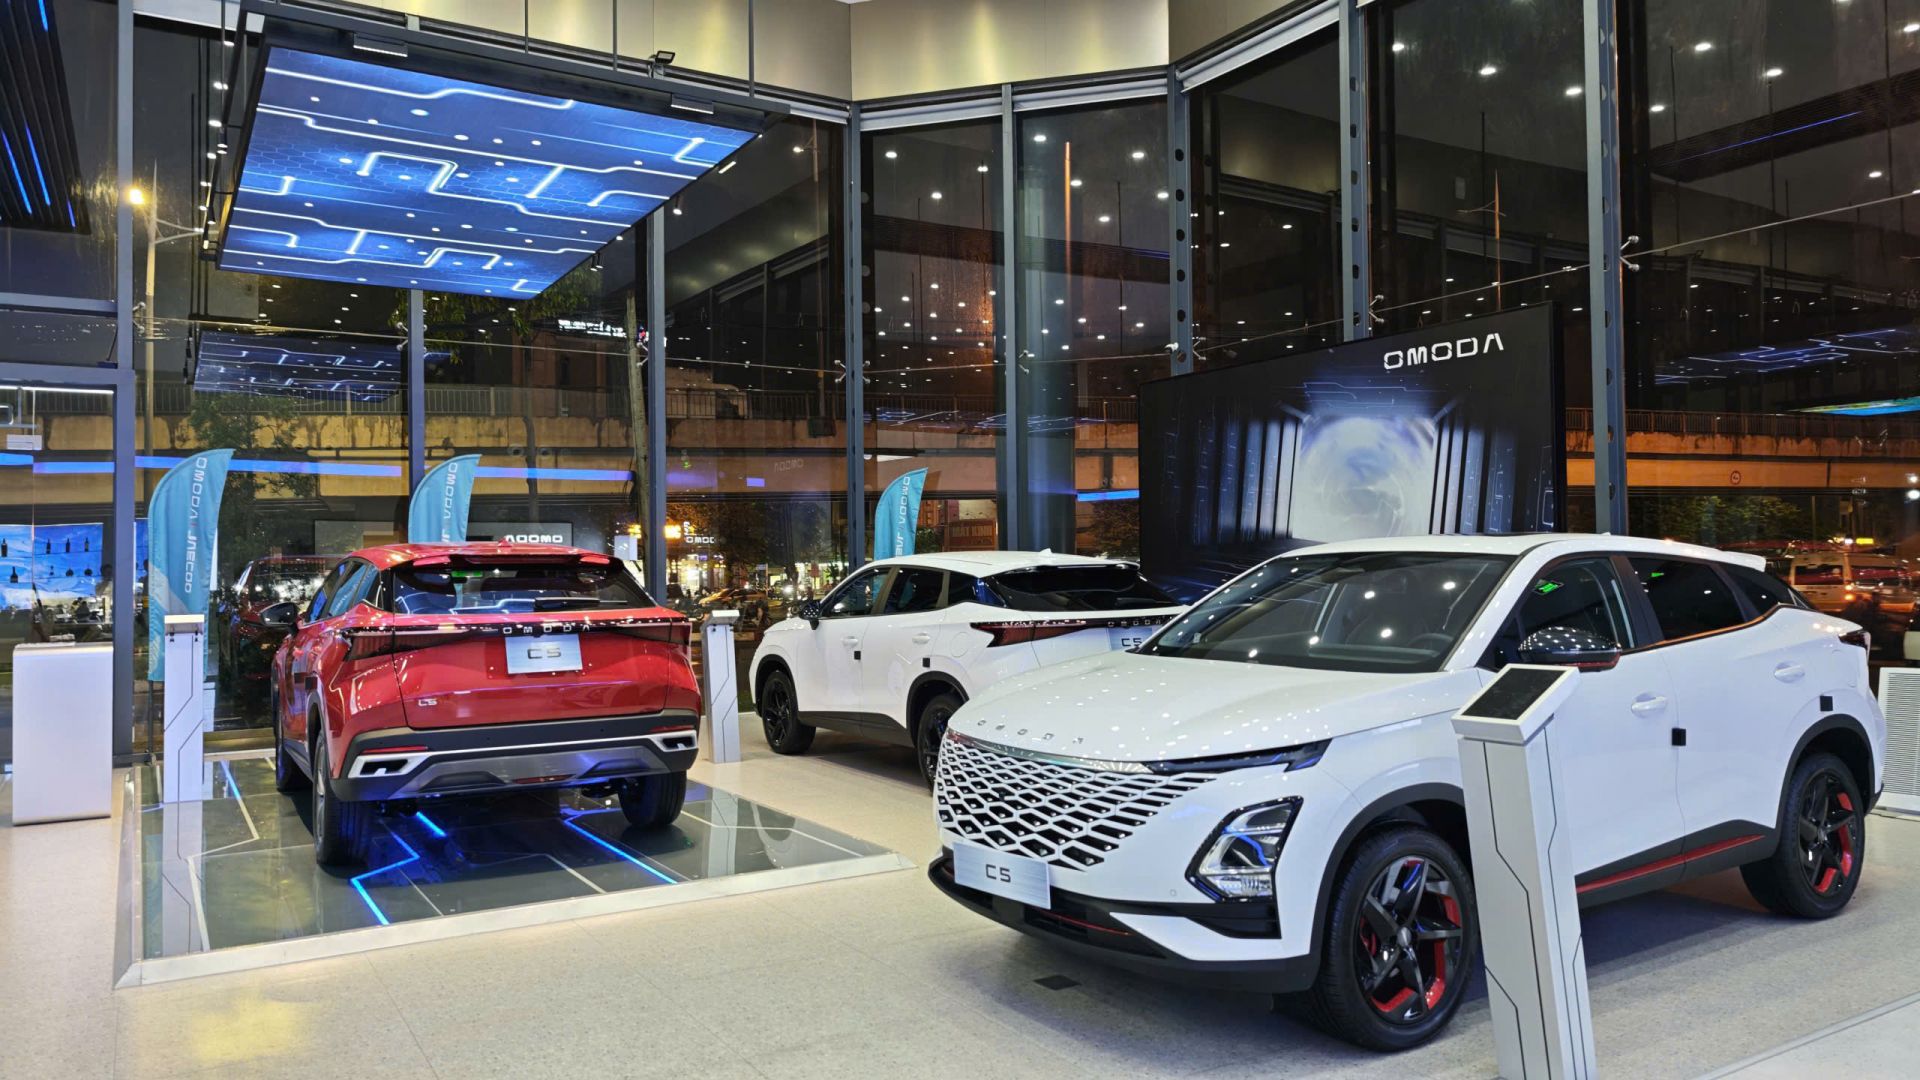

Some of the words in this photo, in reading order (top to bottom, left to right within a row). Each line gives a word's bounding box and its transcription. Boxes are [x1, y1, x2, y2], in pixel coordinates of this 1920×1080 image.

[1383, 333, 1504, 370] OMODA
[189, 456, 208, 519] OMODA
[443, 462, 458, 519] OMODA
[898, 476, 911, 525] OMODA
[502, 624, 591, 634] OMODA
[1121, 637, 1142, 647] C5
[527, 647, 562, 660] C5
[985, 863, 1011, 883] C5
